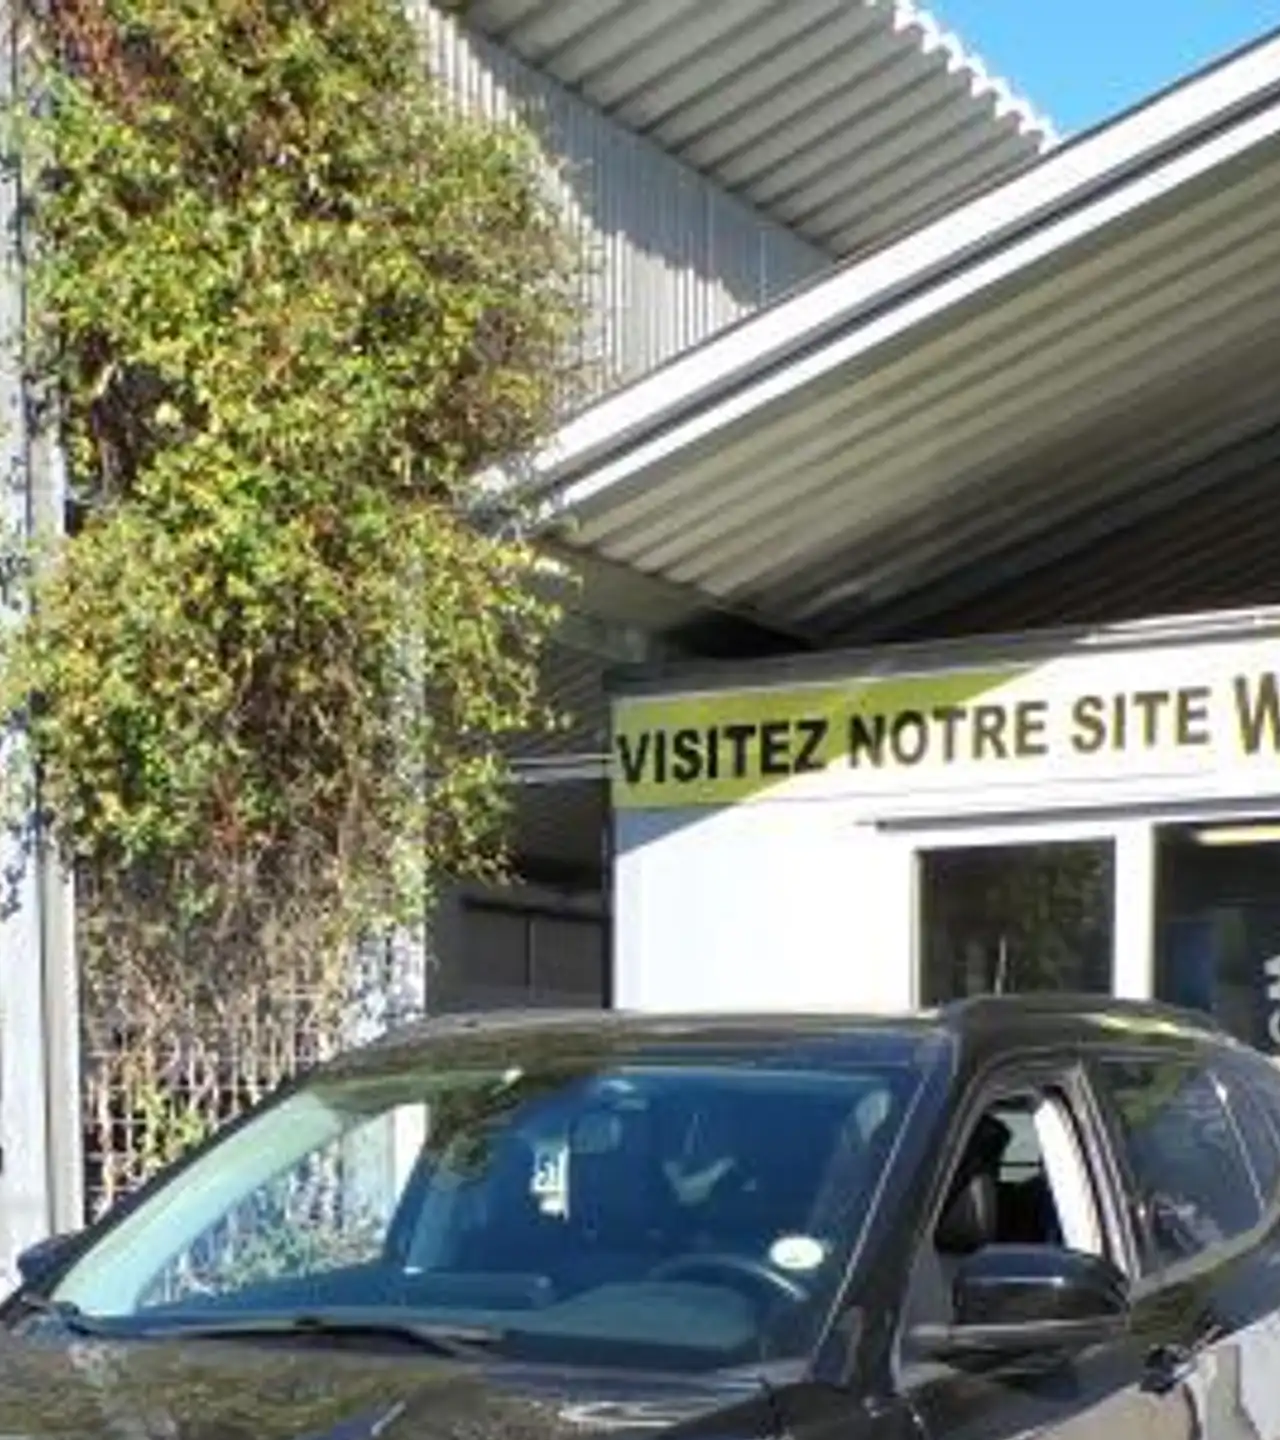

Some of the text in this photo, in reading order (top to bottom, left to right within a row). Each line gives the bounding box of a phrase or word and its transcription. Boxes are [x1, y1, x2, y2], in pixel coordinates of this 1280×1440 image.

[616, 719, 828, 783] VISITEZ
[849, 700, 1049, 768] NOTRE
[1071, 686, 1211, 753] SITE
